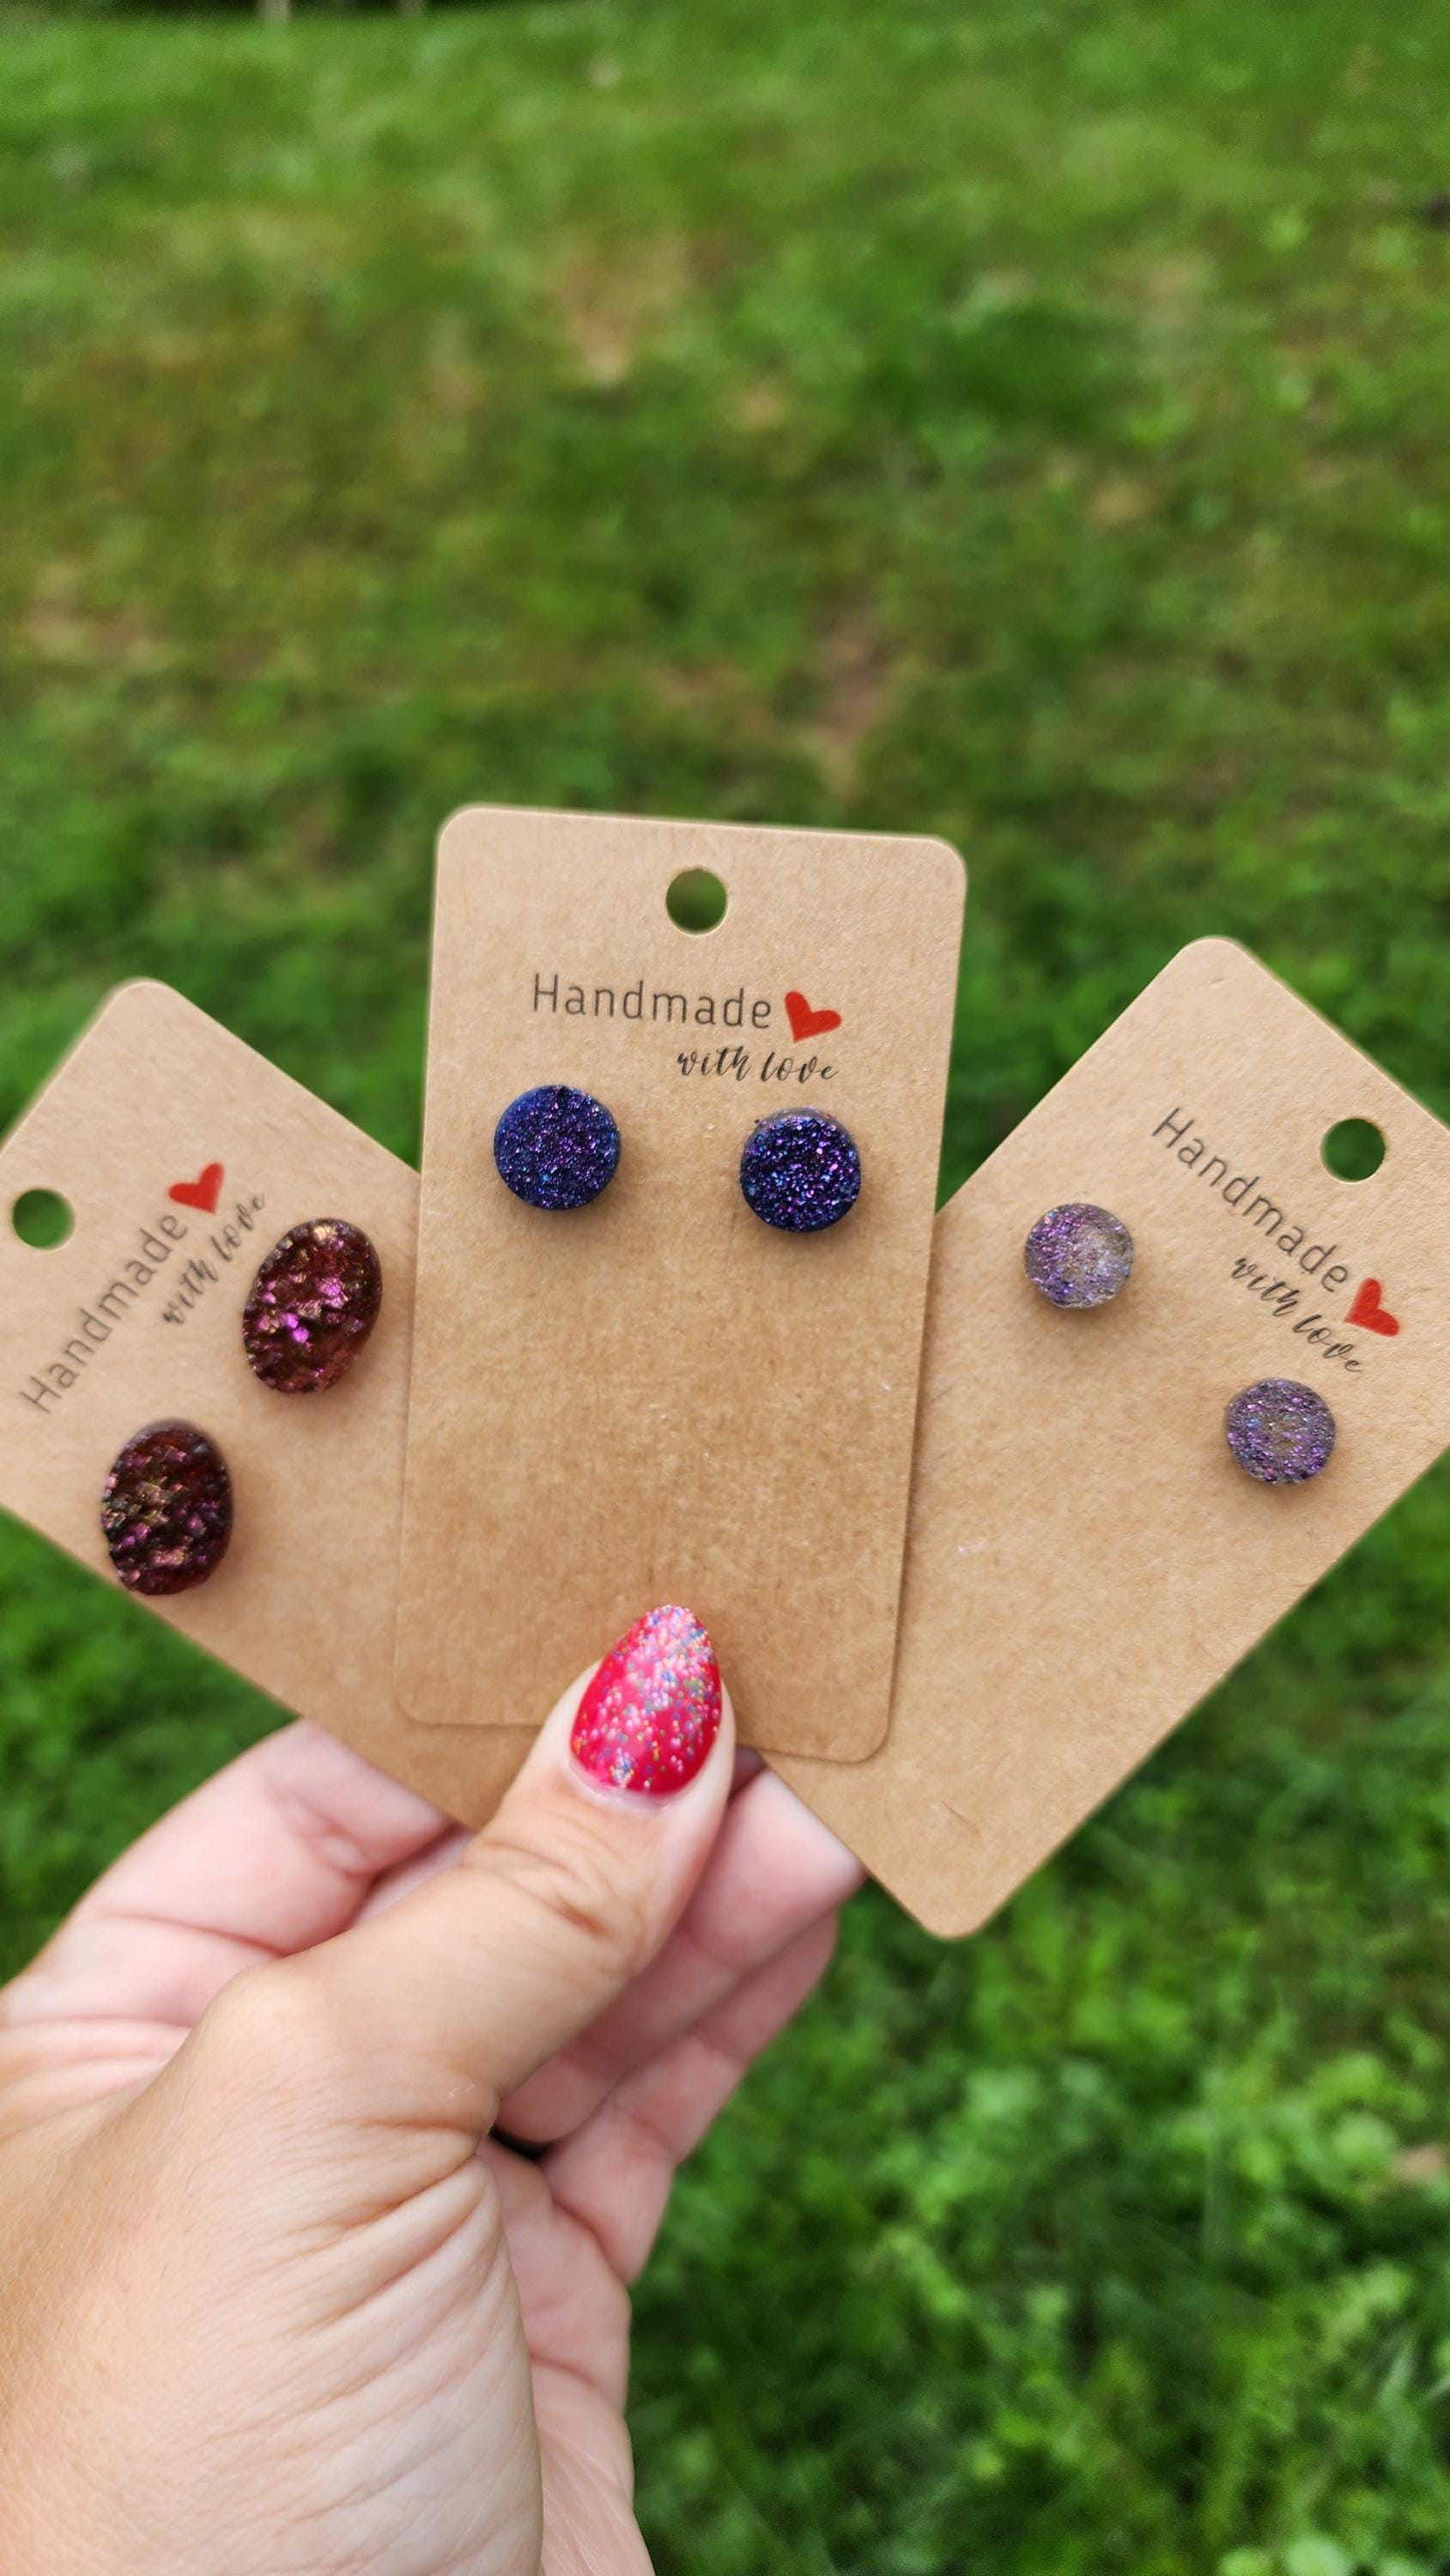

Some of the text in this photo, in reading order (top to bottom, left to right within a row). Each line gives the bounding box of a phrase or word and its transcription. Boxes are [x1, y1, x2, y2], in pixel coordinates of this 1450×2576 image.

[533, 973, 771, 1029] Handmade
[676, 1045, 838, 1084] with love
[162, 1193, 265, 1325] with love
[1151, 1107, 1349, 1292] Handmade
[19, 1213, 188, 1413] Handmade
[1231, 1257, 1362, 1372] with love
